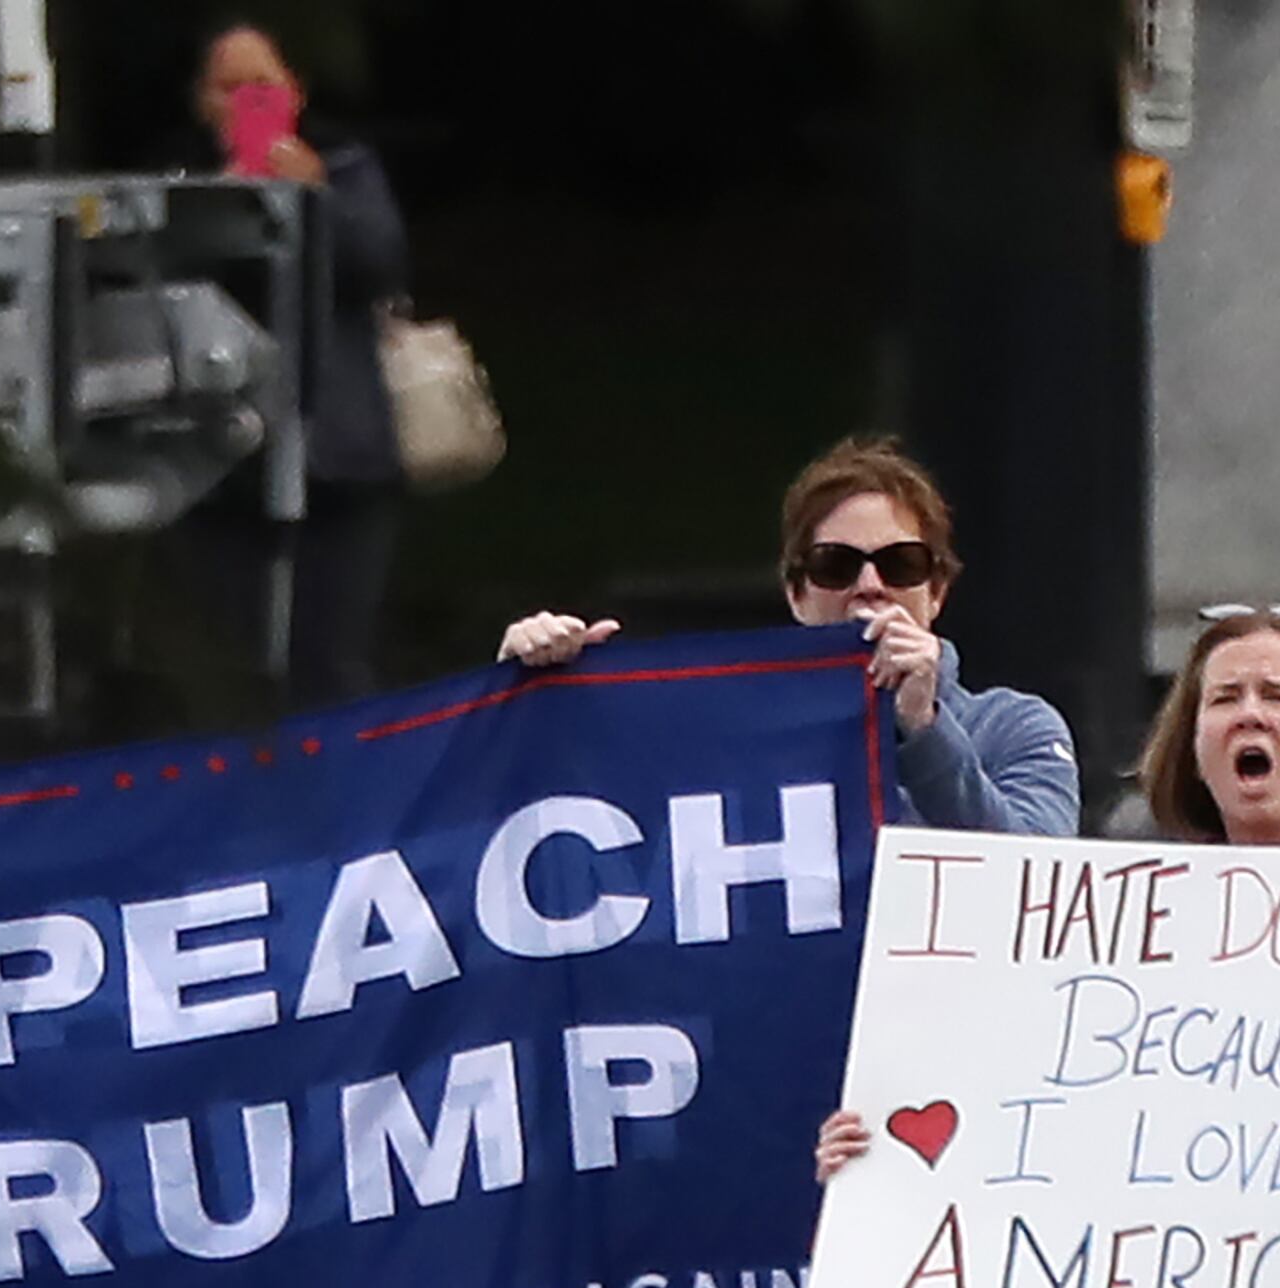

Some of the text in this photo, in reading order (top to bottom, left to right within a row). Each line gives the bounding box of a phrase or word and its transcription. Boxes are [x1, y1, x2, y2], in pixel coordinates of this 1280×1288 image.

[887, 853, 985, 958] I
[1011, 858, 1191, 965] HATE
[983, 1098, 1068, 1185] I
